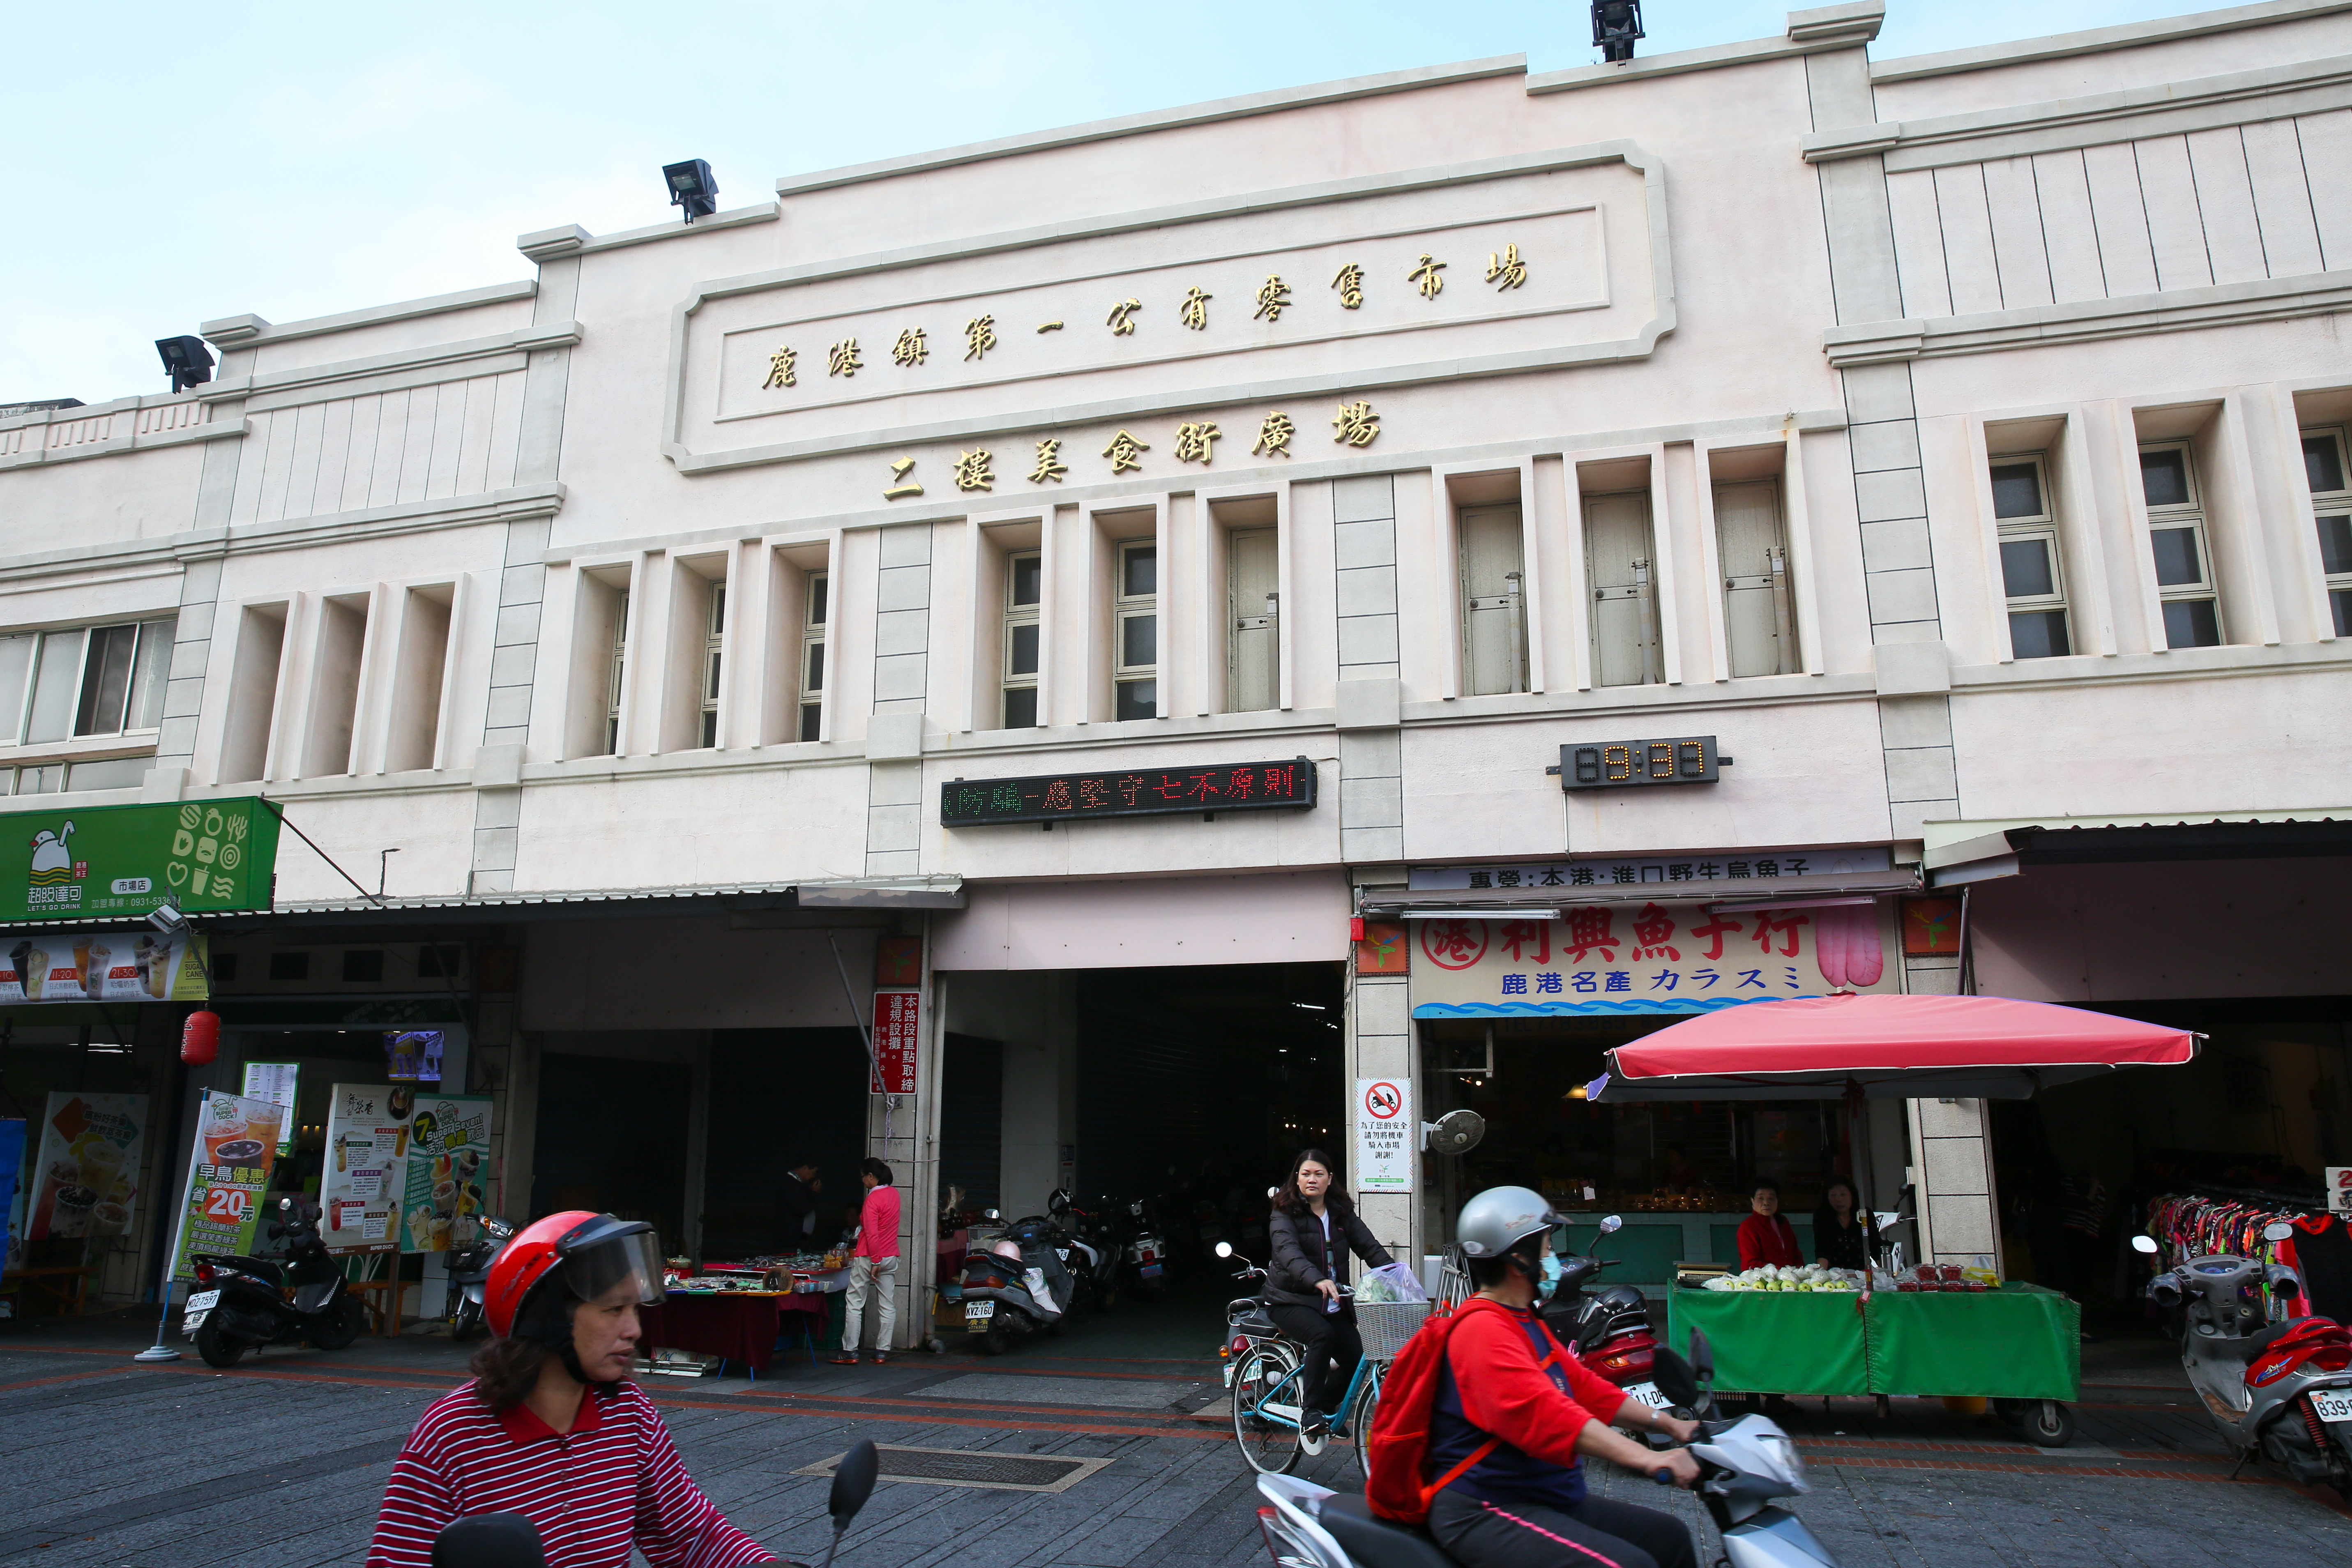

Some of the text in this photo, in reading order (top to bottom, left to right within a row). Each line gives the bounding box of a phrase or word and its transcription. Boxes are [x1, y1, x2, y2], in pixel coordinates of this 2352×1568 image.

[761, 242, 1527, 389] 鹿港鎮第一公有零售市場
[882, 399, 1381, 500] 二樓美食街廣場
[1604, 741, 1704, 780] 9:37
[119, 880, 146, 891] 市場店
[1500, 900, 1810, 965] 利興魚子行
[113, 968, 135, 977] 21-30
[1501, 966, 1801, 995] 鹿港名產 カラスミ
[901, 995, 917, 1091] 本路段重點取締
[415, 1117, 430, 1141] 7
[426, 1112, 484, 1142] Super Seven!
[439, 1113, 454, 1123] SUPER
[1360, 1121, 1408, 1130] 為了您的安全
[1364, 1131, 1404, 1140] 請勿將機車
[1368, 1141, 1400, 1149] 騎入市場
[1375, 1151, 1394, 1159] 謝謝!
[198, 1163, 266, 1185] 早鳥優惠
[191, 1186, 255, 1223] 省 20 元
[194, 1218, 242, 1234] 極品錫蘭紅茶
